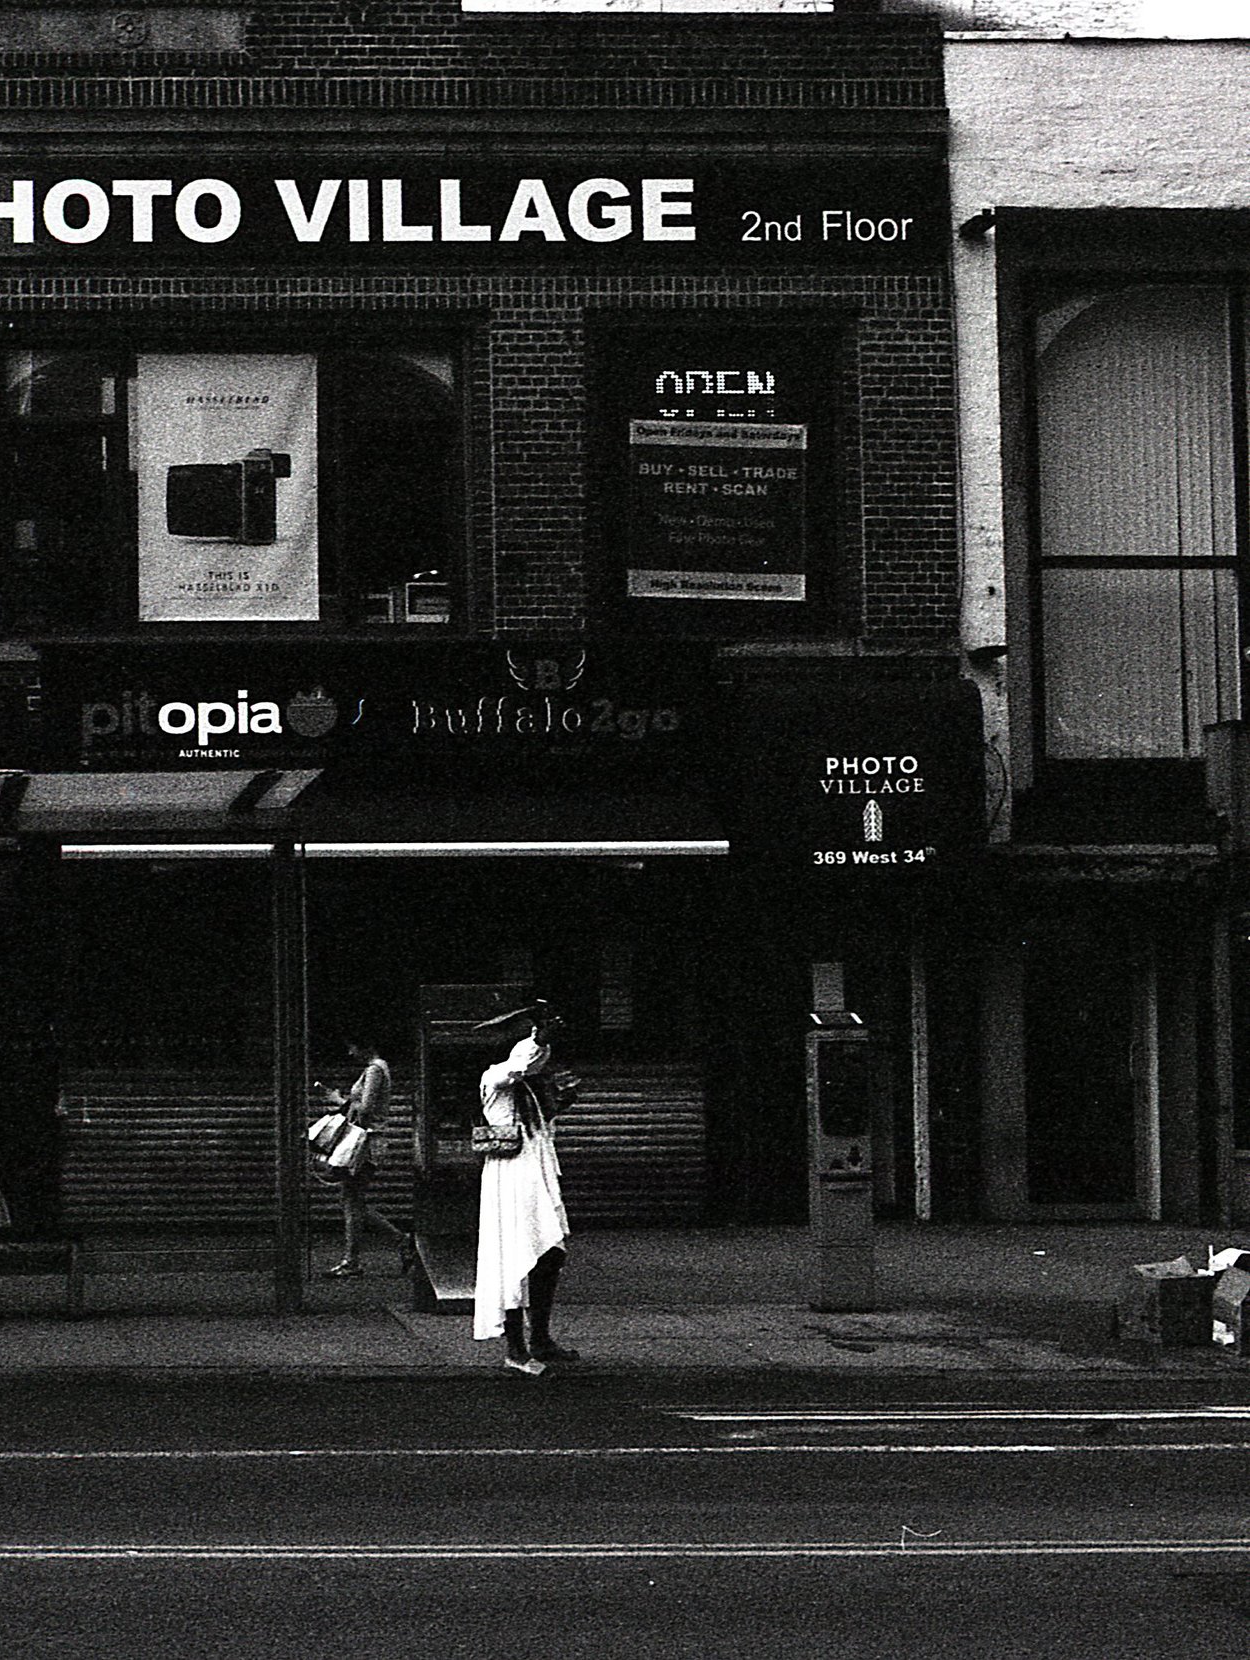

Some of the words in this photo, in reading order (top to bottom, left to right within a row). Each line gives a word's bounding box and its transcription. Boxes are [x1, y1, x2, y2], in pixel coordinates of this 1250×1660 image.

[274, 177, 697, 243] VILLAGE
[740, 210, 802, 242] 2nd
[822, 209, 913, 242] Floor
[638, 463, 674, 476] BUY
[687, 464, 729, 478] SELL
[741, 466, 799, 480] TRADE
[663, 481, 710, 496] RENT
[721, 482, 769, 497] SCAN
[208, 571, 234, 581] THIS
[238, 571, 250, 581] IS
[81, 689, 284, 748] pitopia
[178, 749, 241, 759] AUTHENTIC
[825, 755, 919, 775] PHOTO
[819, 777, 926, 794] VILLAGE
[813, 850, 848, 865] 369
[851, 850, 899, 865] West
